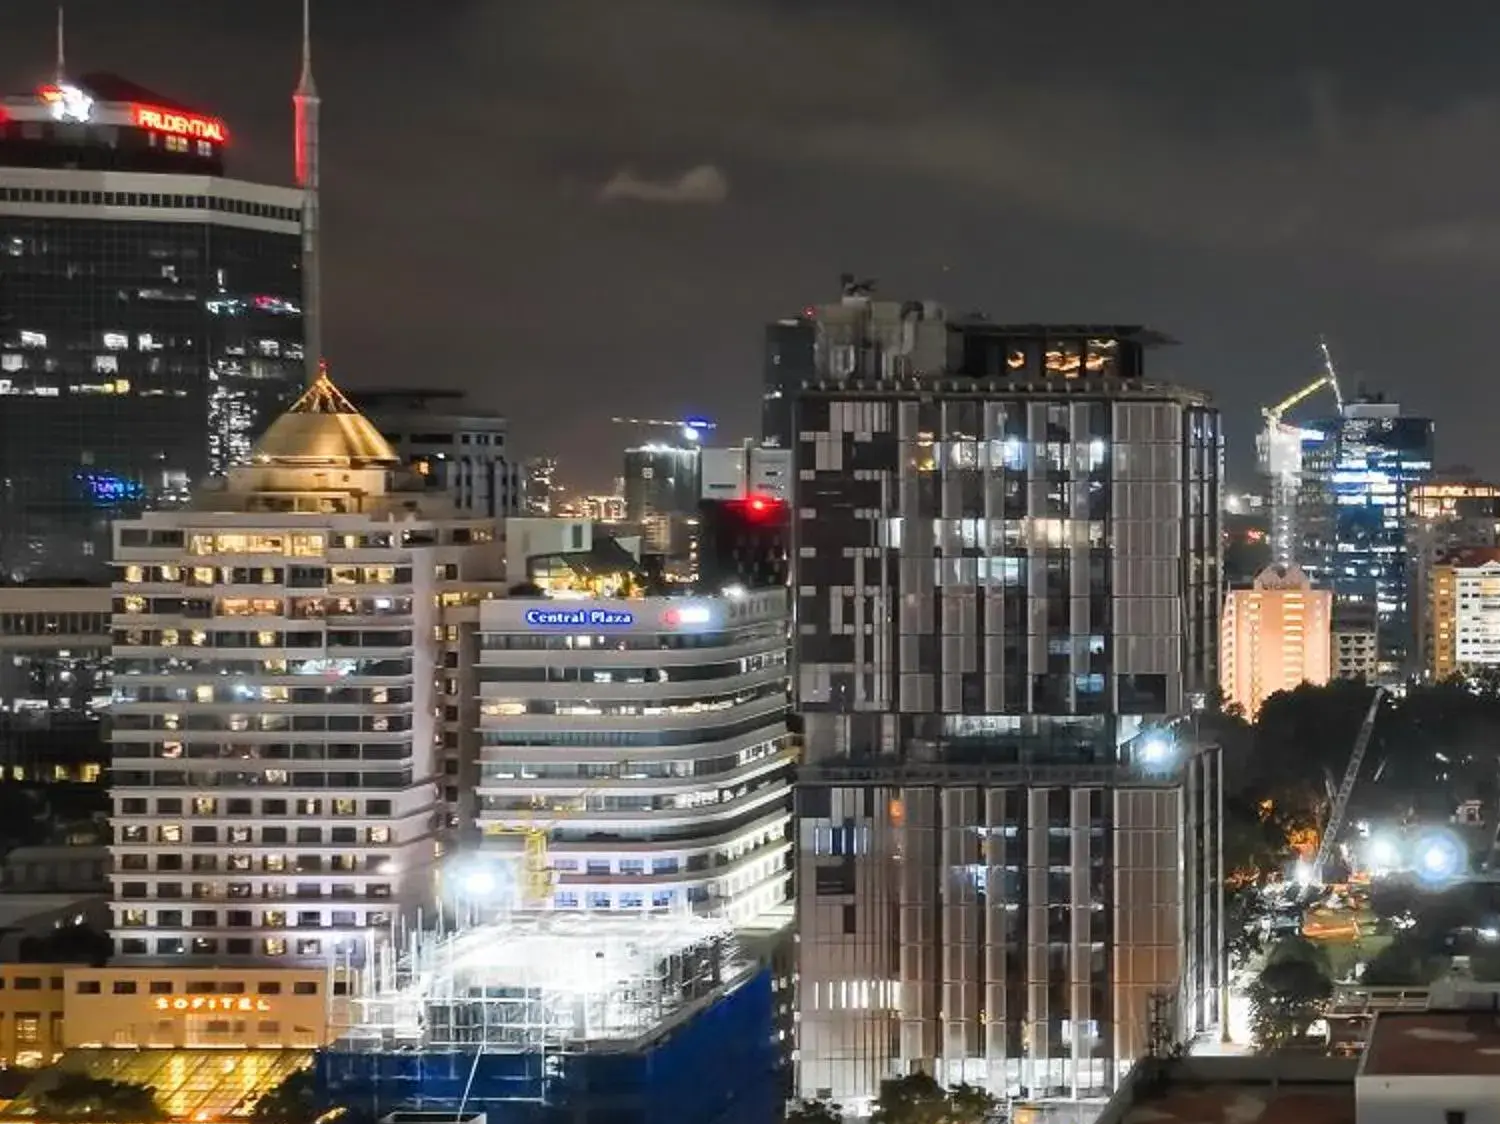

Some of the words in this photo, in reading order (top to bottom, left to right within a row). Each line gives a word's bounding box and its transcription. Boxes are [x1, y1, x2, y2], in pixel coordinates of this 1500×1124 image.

[139, 108, 225, 141] PRUDENTIAL
[526, 609, 585, 624] Central
[590, 609, 633, 624] Plaza
[155, 996, 272, 1011] SOFITEL
